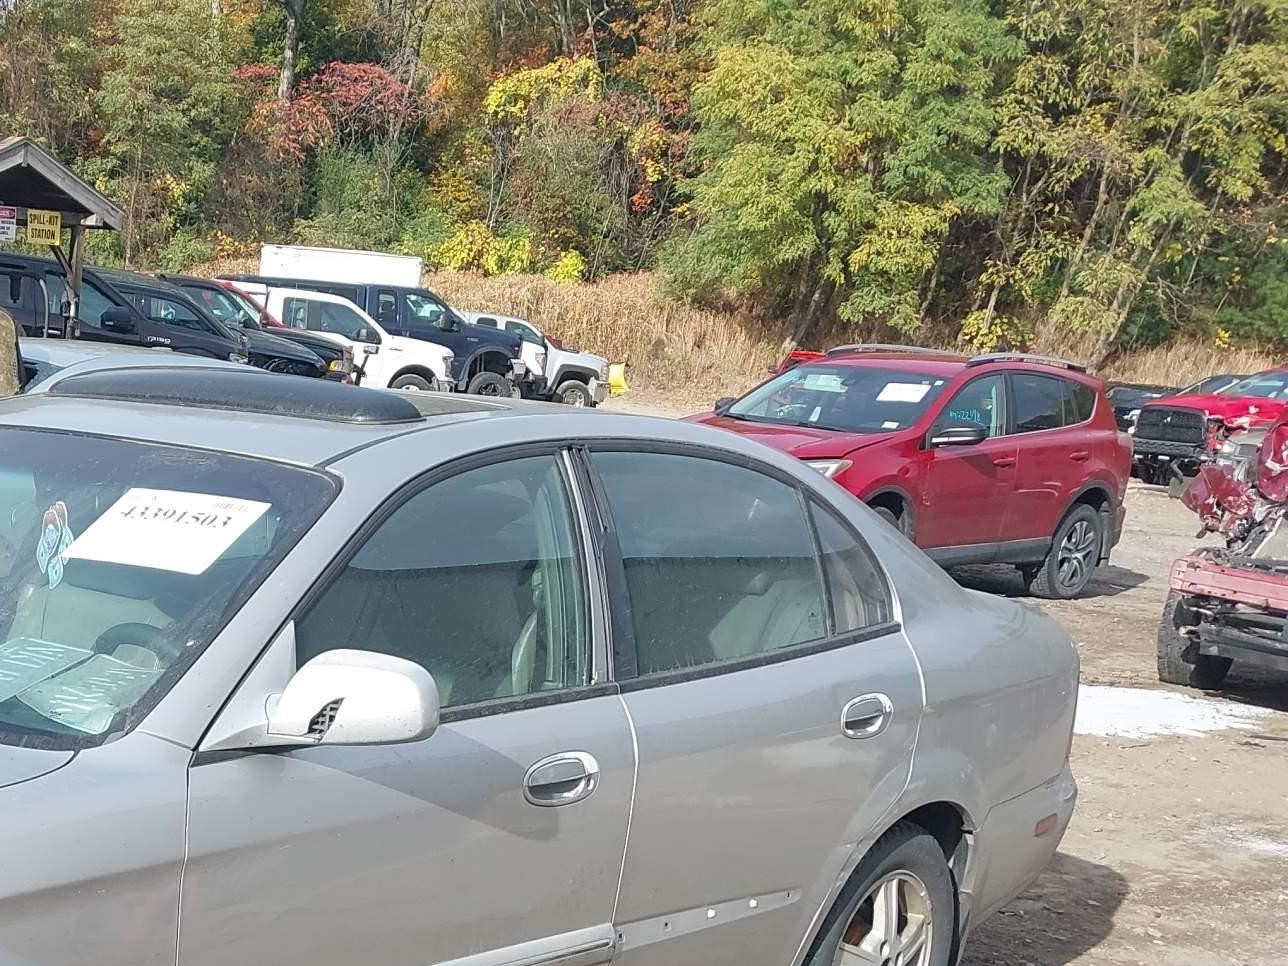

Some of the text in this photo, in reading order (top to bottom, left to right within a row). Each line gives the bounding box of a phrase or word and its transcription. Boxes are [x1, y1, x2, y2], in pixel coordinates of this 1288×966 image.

[29, 213, 59, 226] SPILL-KIT
[30, 227, 56, 240] STATION
[120, 505, 233, 529] 43391503
